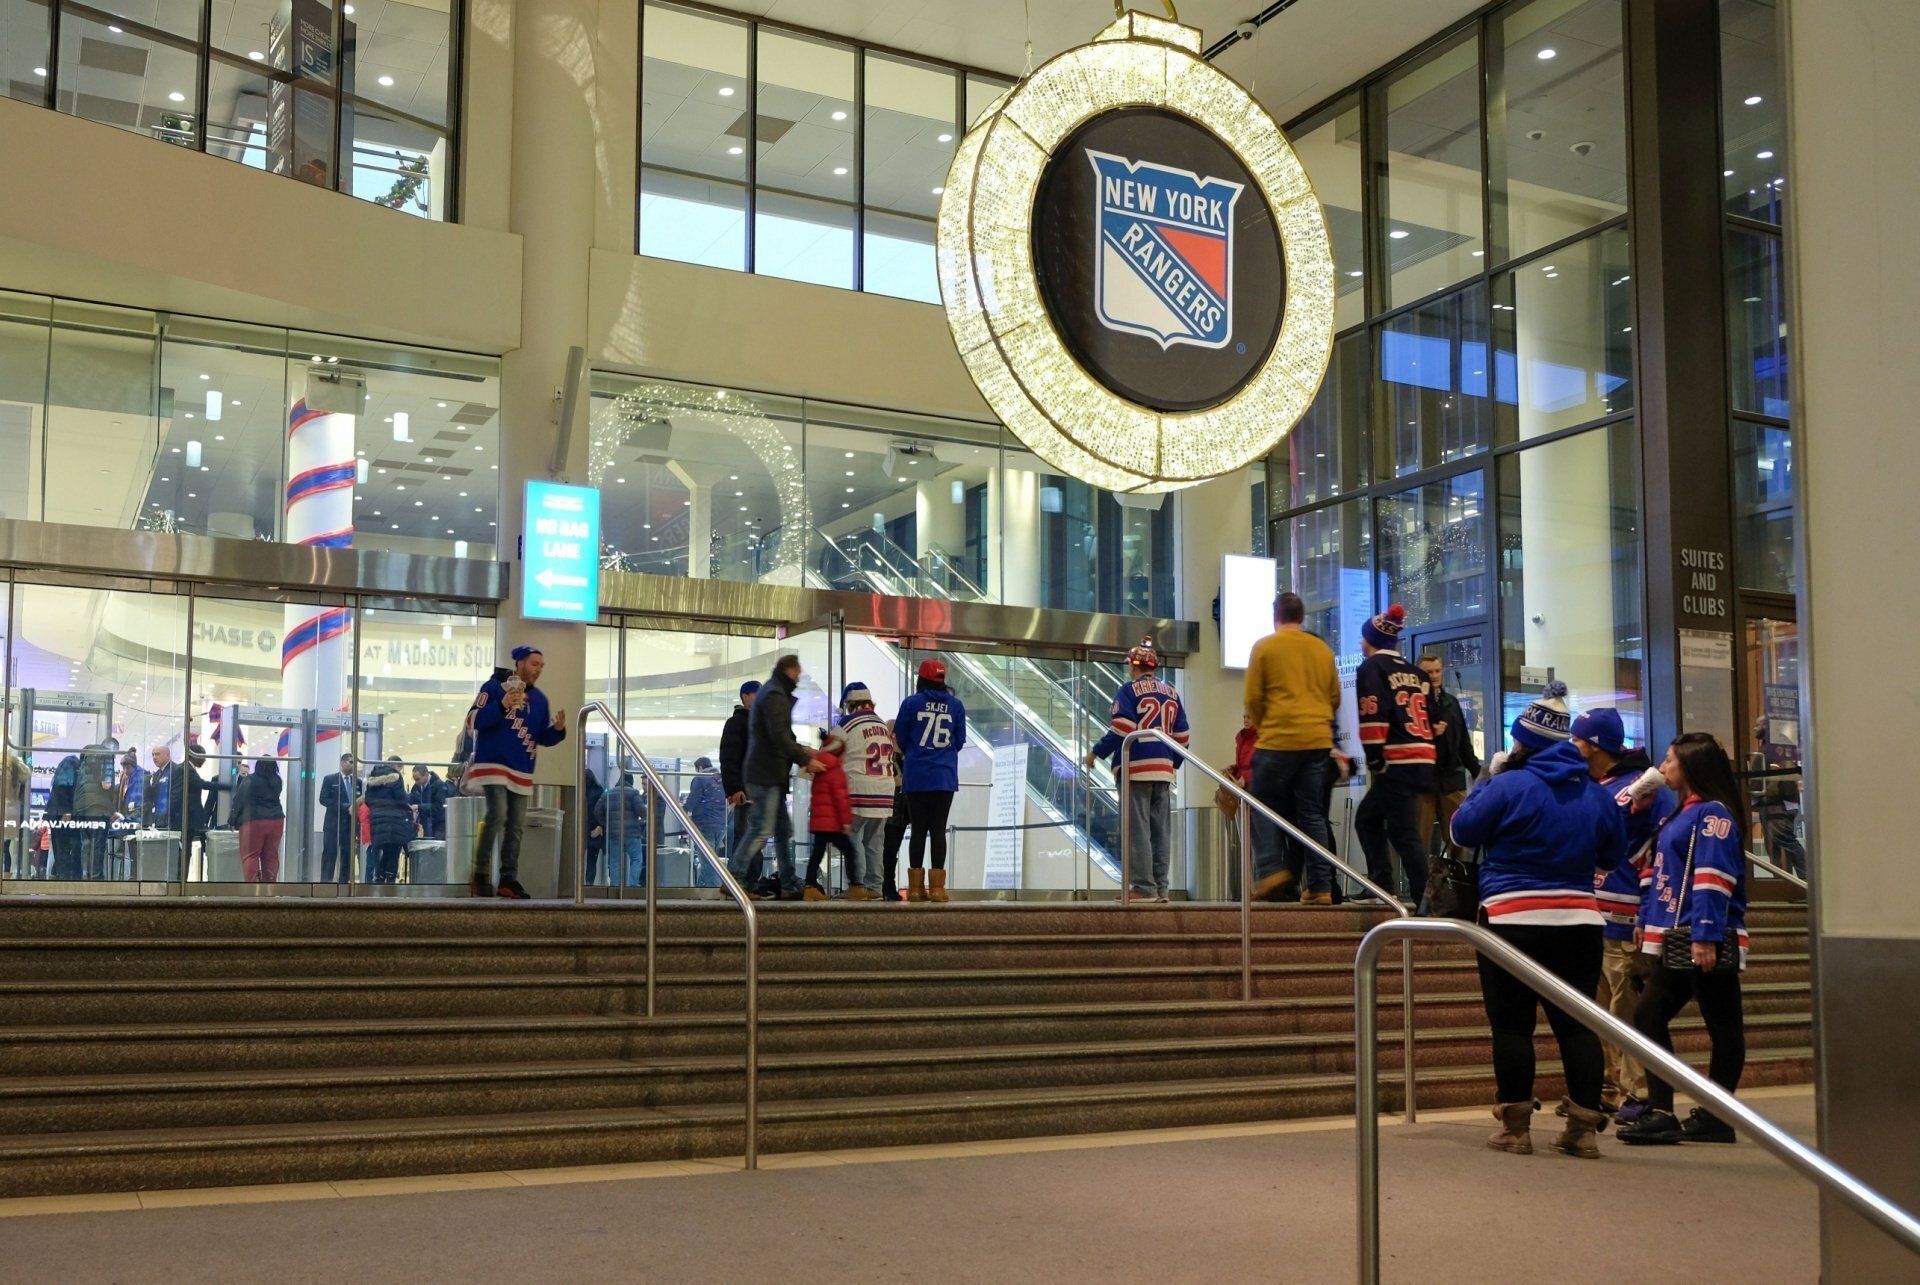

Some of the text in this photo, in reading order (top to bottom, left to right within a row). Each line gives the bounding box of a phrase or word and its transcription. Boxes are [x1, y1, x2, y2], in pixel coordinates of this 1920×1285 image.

[1105, 176, 1225, 229] NEW YORK
[1121, 222, 1221, 332] RANGERS
[1681, 548, 1725, 571] SUITES
[1691, 572, 1716, 591] AND
[1683, 595, 1726, 617] CLUBS
[363, 645, 382, 660] AT
[387, 640, 458, 667] MADISON
[1343, 680, 1356, 689] LEVE
[925, 702, 948, 713] SKJEI
[1136, 697, 1179, 736] 20
[916, 711, 953, 748] 76
[1701, 815, 1731, 840] 30
